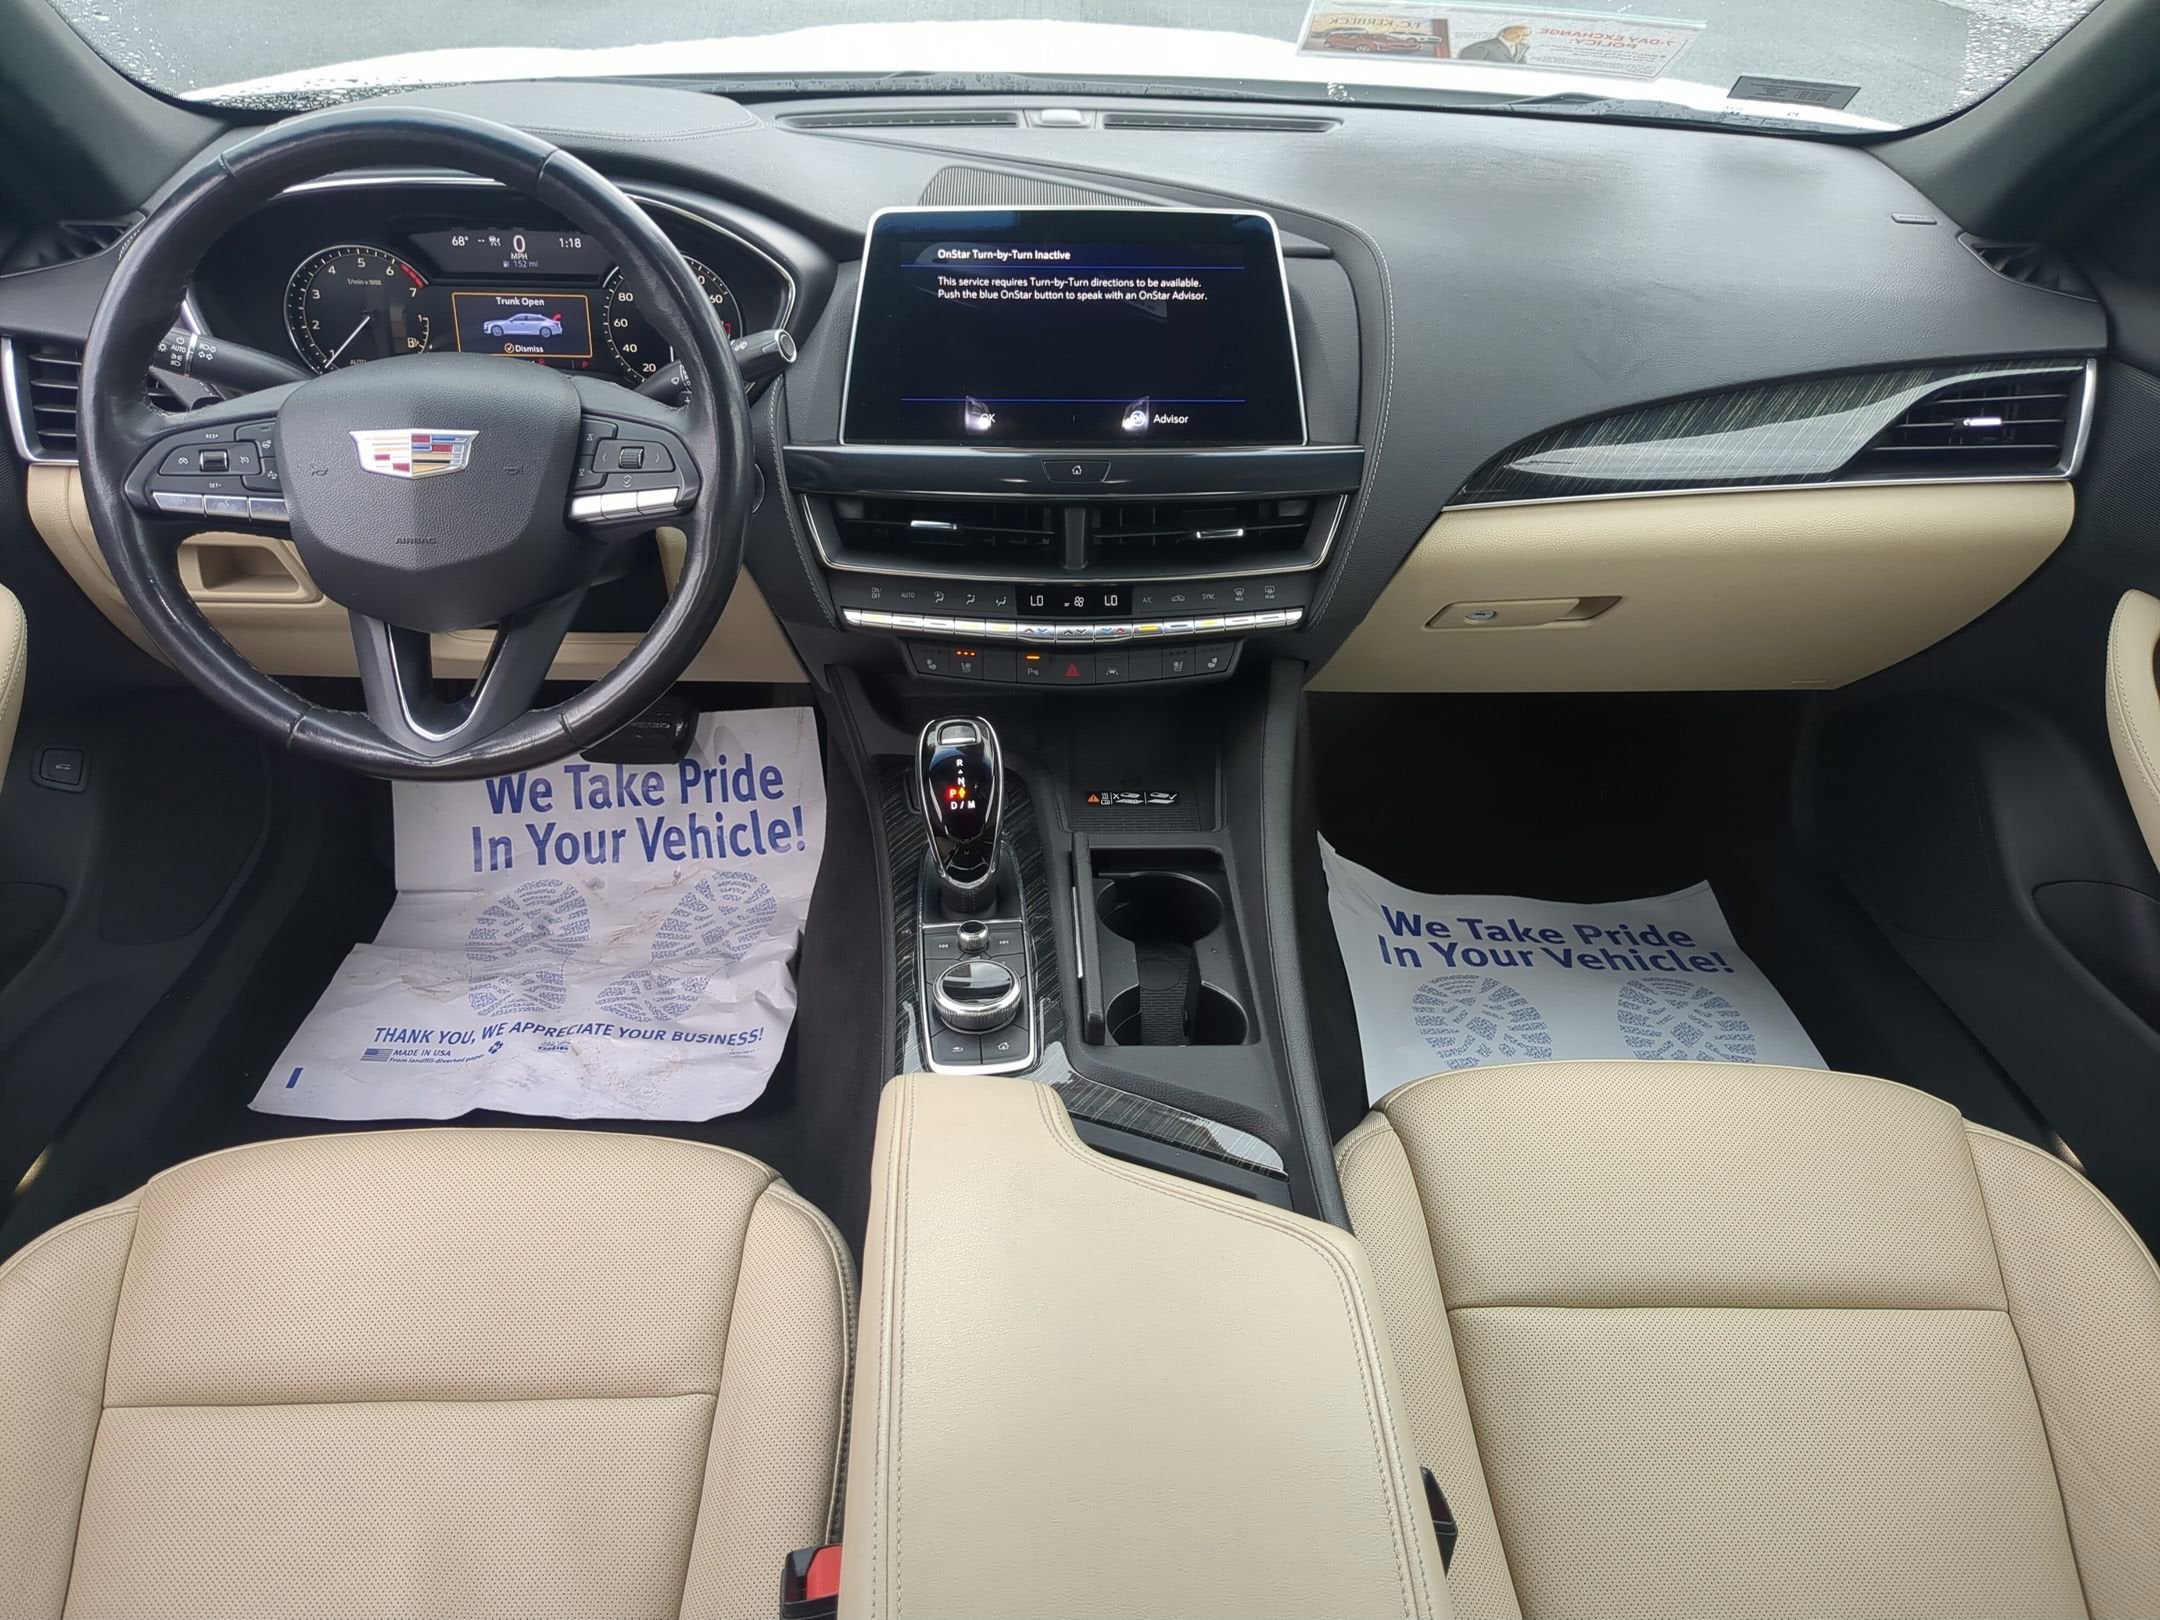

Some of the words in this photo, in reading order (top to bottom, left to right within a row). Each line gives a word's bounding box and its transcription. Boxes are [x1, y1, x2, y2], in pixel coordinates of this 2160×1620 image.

[513, 234, 526, 253] 0
[559, 238, 582, 248] 1:18
[511, 252, 528, 260] MPH
[937, 249, 971, 259] OnStar
[972, 249, 1033, 261] Turn-by-Turn
[1035, 250, 1071, 260] Inactive
[357, 257, 366, 268] 5
[513, 260, 527, 268] 152
[529, 260, 539, 268] mi
[328, 265, 336, 275] 4
[386, 266, 395, 276] 6
[937, 276, 957, 286] This
[958, 277, 990, 286] service
[991, 277, 1028, 288] requires
[1029, 277, 1089, 289] Turn-by-Turn
[1090, 277, 1135, 287] directions
[1136, 279, 1146, 287] to
[1147, 278, 1159, 287] be
[1160, 277, 1202, 288] available.
[312, 289, 321, 299] 3
[409, 287, 417, 298] 7
[618, 292, 634, 302] 80
[937, 289, 961, 299] Push
[962, 289, 978, 299] the
[979, 289, 999, 299] blue
[1000, 290, 1033, 299] OnStar
[1034, 290, 1064, 299] button
[1065, 291, 1075, 300] to
[1077, 290, 1103, 301] speak
[1104, 290, 1124, 300] with
[1125, 292, 1137, 300] an
[1138, 290, 1171, 300] OnStar
[1172, 290, 1208, 301] Advisor.
[496, 297, 521, 306] Trunk
[521, 297, 545, 307] Open
[312, 320, 321, 330] 2
[613, 318, 629, 328] 60
[171, 344, 187, 353] AUTO
[515, 345, 544, 353] Dismiss
[622, 343, 638, 353] 40
[642, 363, 657, 373] 20
[1153, 414, 1189, 424] Advisor
[956, 759, 963, 767] R
[485, 771, 554, 815] We
[564, 762, 666, 811] Take
[678, 752, 785, 805] Pride
[958, 777, 965, 786] N
[949, 789, 957, 799] P
[471, 825, 514, 872] In
[525, 821, 627, 866] Your
[635, 804, 806, 863] Vehicle!
[1380, 904, 1451, 939] We
[1456, 917, 1566, 945] Take
[1572, 923, 1697, 949] Pride
[1377, 934, 1423, 969] In
[1427, 941, 1534, 969] Your
[1540, 947, 1736, 975] Vehicle!
[372, 1027, 434, 1045] THANK
[438, 1030, 476, 1046] YOU,
[481, 1022, 508, 1040] WE
[508, 1021, 615, 1038] APPRECIATE
[618, 1026, 667, 1041] YOUR
[671, 1027, 765, 1046] BUSINESS!
[465, 1053, 485, 1063] paper
